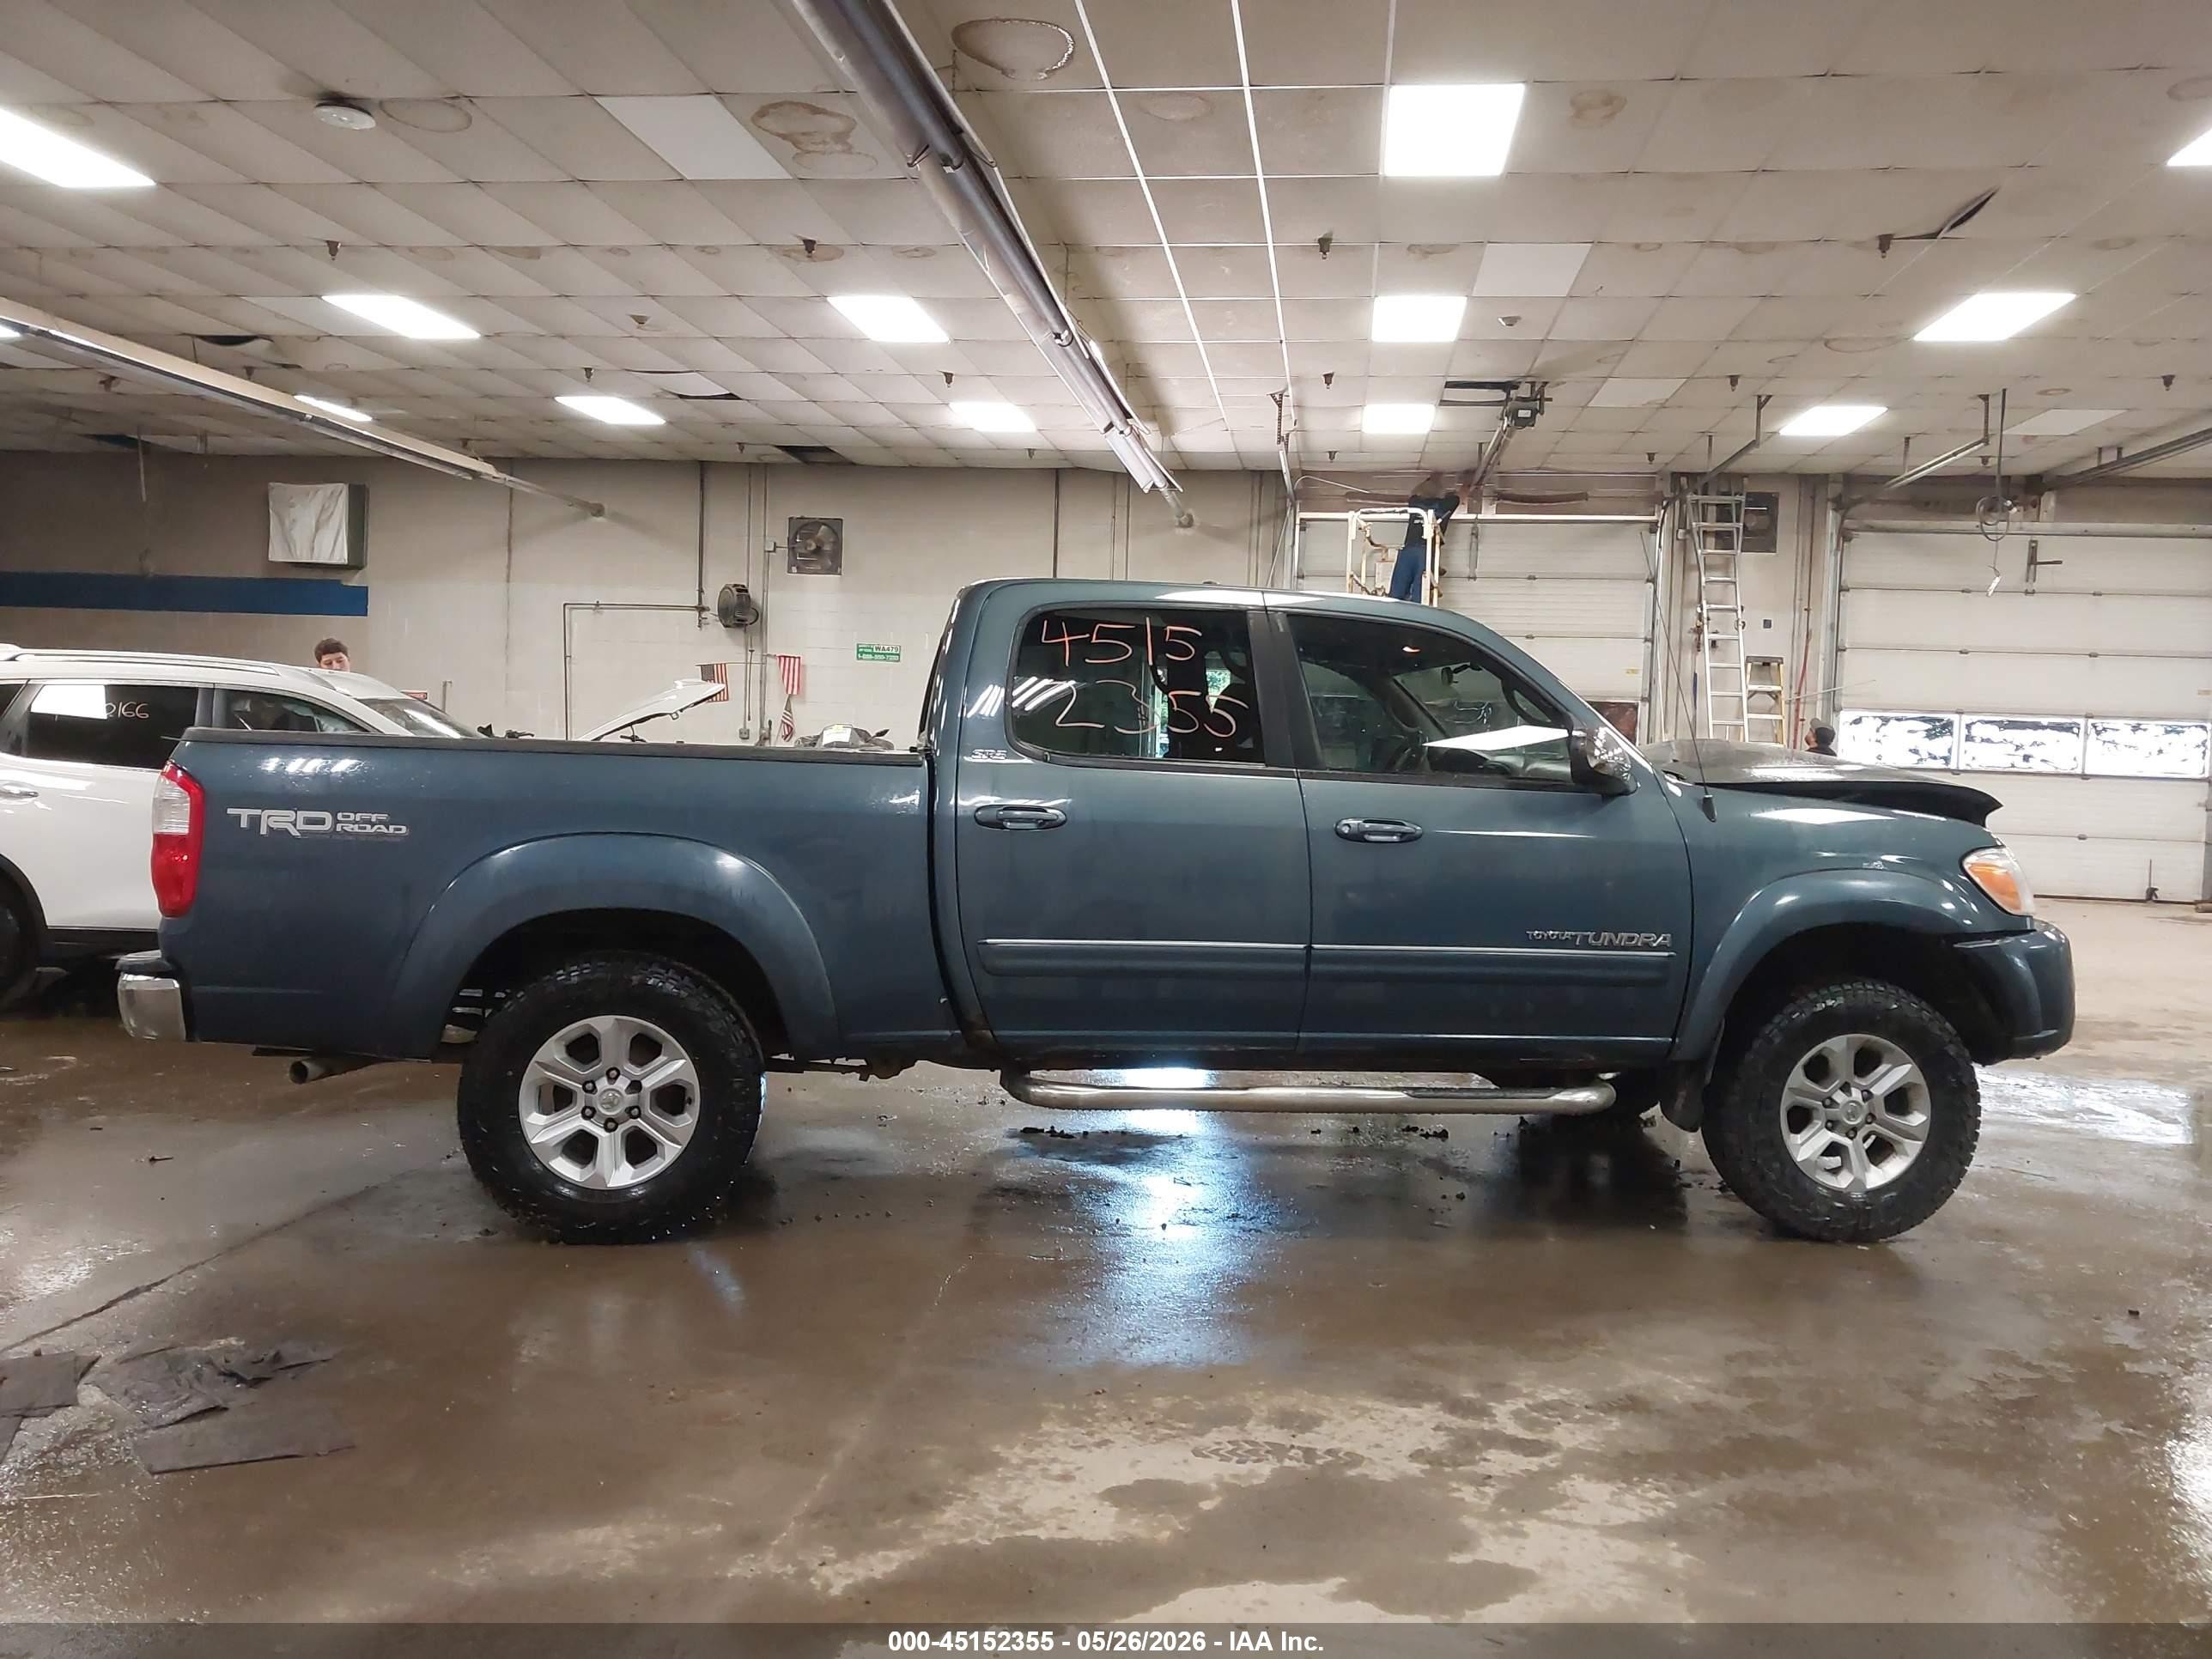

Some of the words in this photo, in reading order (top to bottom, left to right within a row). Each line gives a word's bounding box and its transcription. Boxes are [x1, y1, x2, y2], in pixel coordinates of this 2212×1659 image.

[1041, 616, 1203, 667] 4515
[1049, 678, 1249, 738] 2355
[227, 807, 332, 836] TRD
[337, 812, 389, 822] OFF
[336, 823, 408, 834] ROAD
[1526, 931, 1572, 940] TOYOTA
[1572, 932, 1672, 947] TUNDRA
